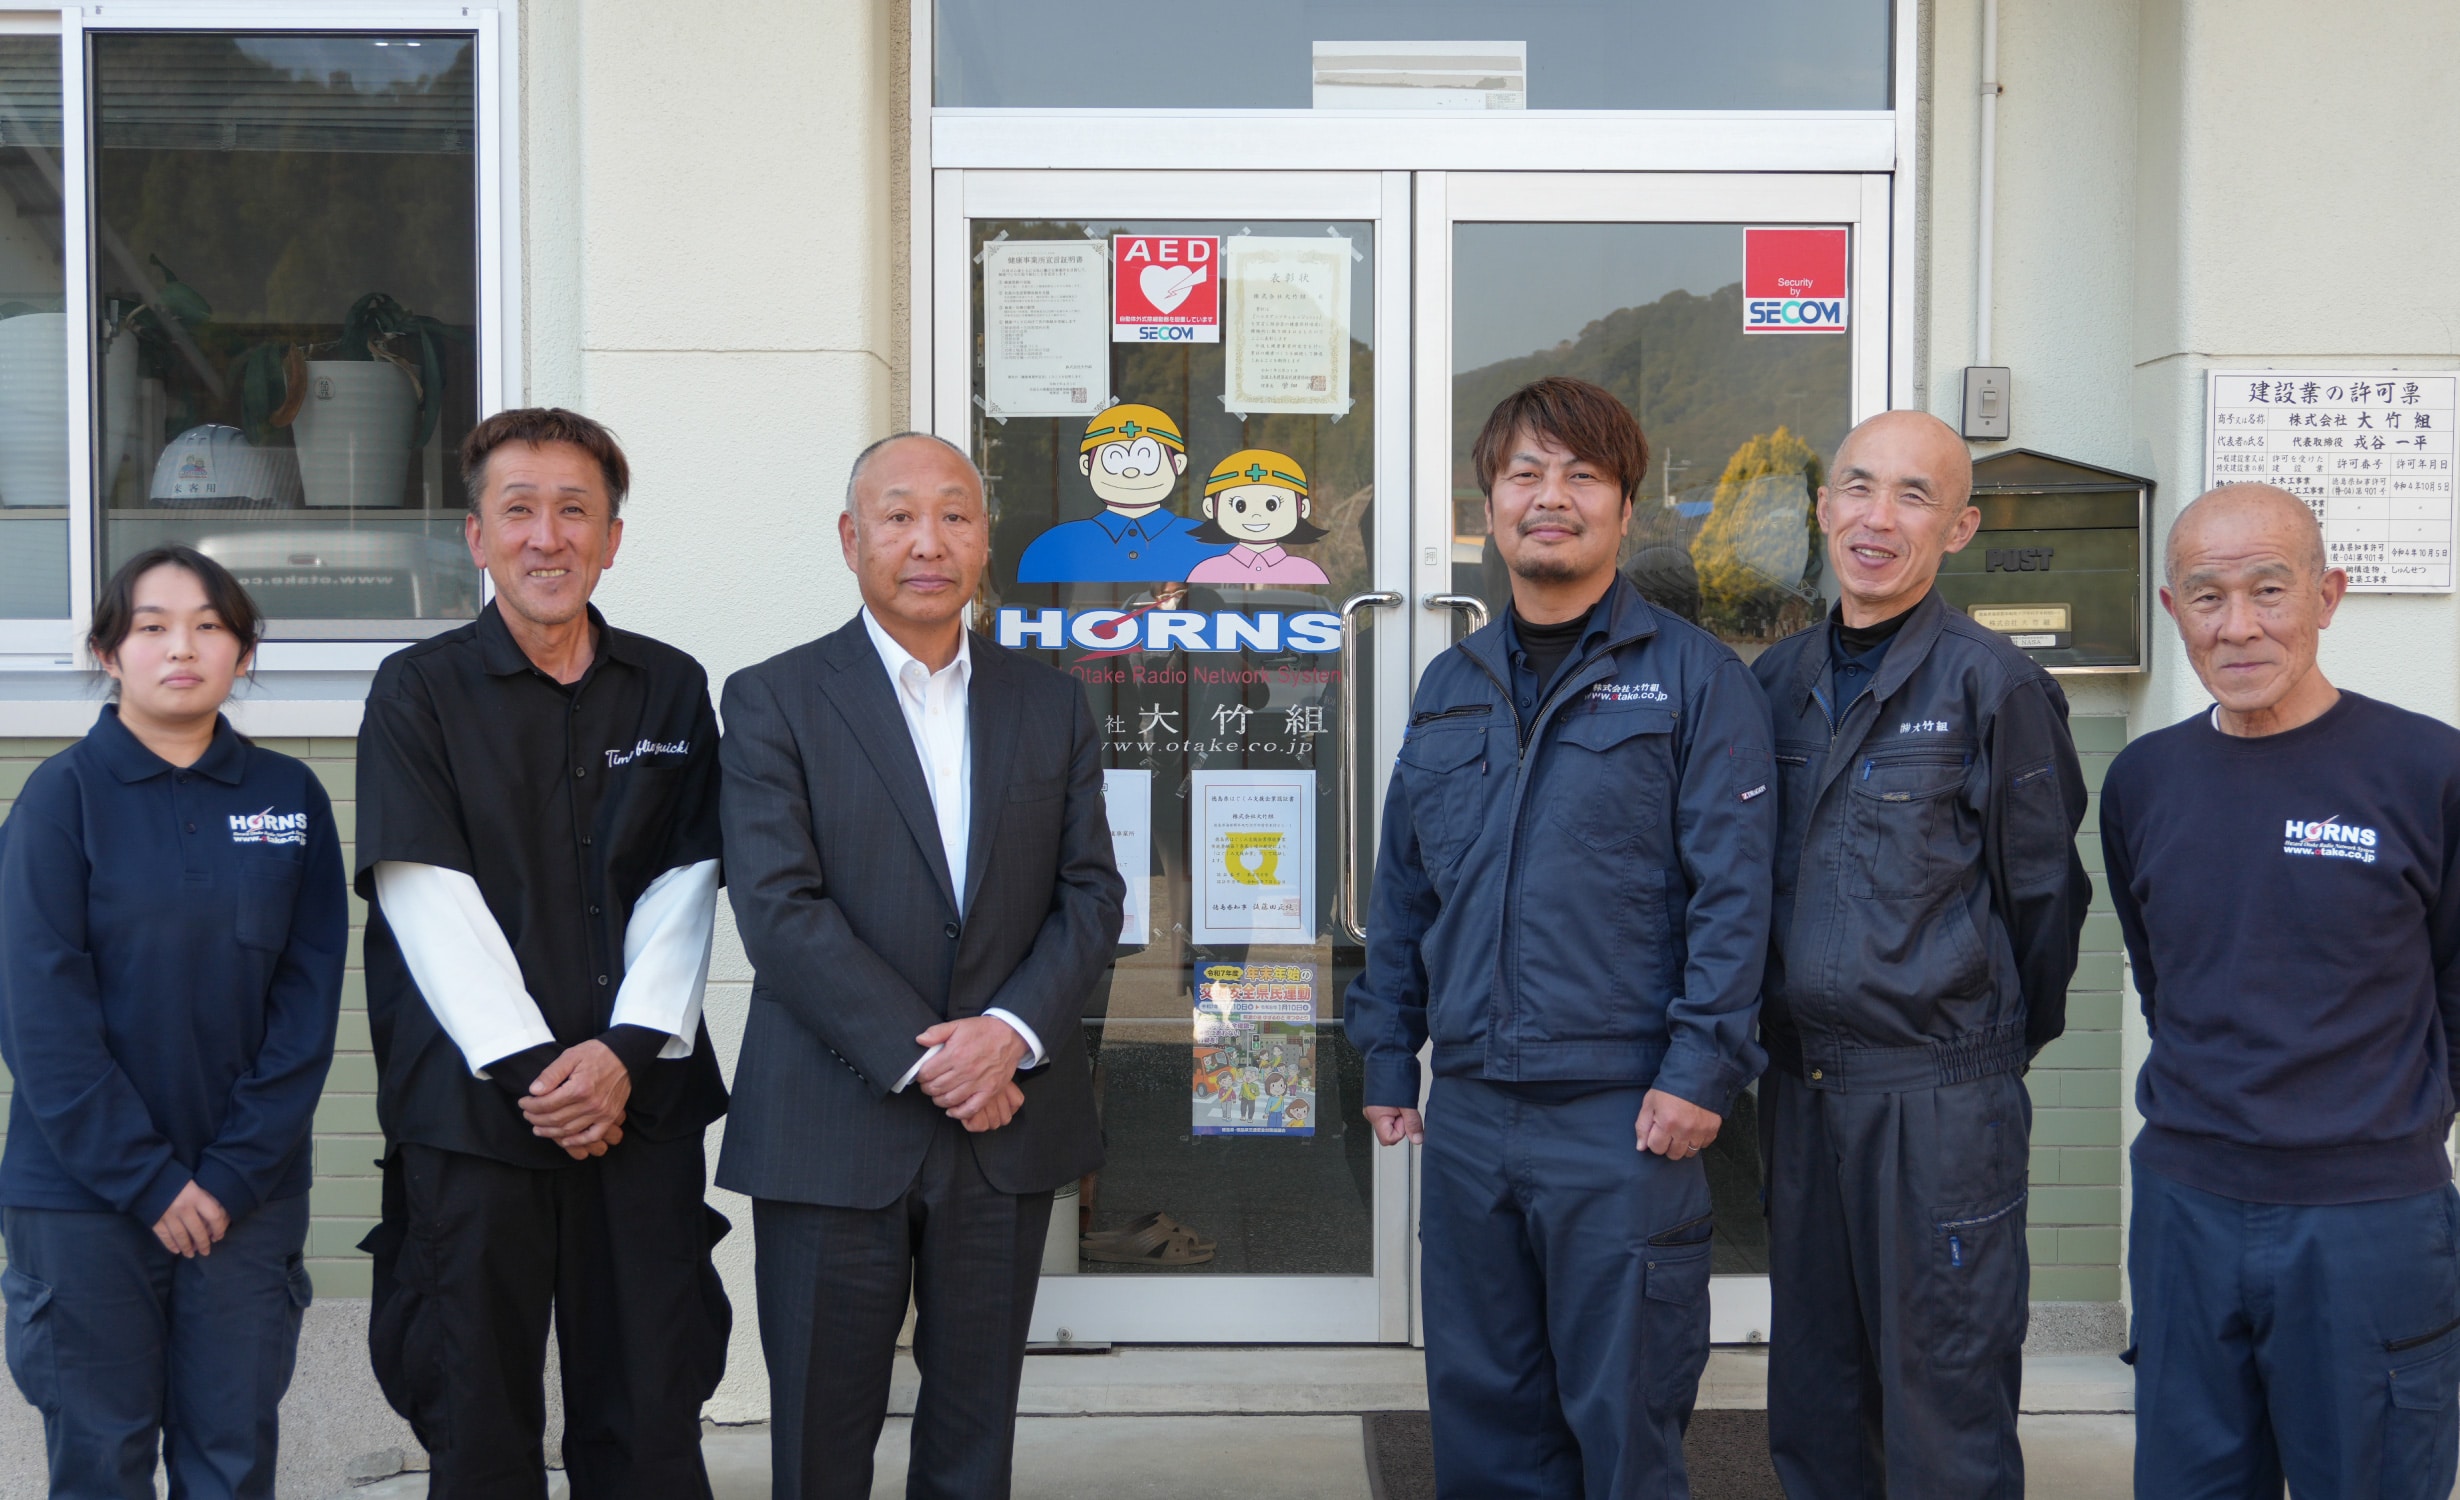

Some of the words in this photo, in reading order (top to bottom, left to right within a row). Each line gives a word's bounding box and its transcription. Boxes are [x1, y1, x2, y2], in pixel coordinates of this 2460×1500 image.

[1124, 240, 1211, 262] AED
[1271, 272, 1310, 283] 表彰状
[1778, 278, 1813, 289] Security
[1790, 287, 1801, 298] by
[1750, 300, 1841, 325] SECOM
[1139, 326, 1194, 341] SECOM
[2248, 380, 2422, 405] 建設業の許可票
[2217, 413, 2266, 425] 商号又は名称
[2289, 412, 2348, 427] 株式会社
[2357, 410, 2432, 429] 大竹組
[2217, 436, 2265, 447] 代表者の氏名
[2292, 436, 2344, 448] 代表取締役
[2272, 454, 2324, 463] 許可を受けた
[2336, 458, 2383, 469] 許可番号
[2396, 458, 2448, 470] 許可年月日
[2269, 476, 2311, 485] 土木工事業
[1985, 547, 2054, 572] POST
[996, 606, 1341, 652] HORNS
[1133, 665, 1187, 684] Radio
[1194, 665, 1271, 684] Network
[229, 812, 308, 830] HORNS
[2285, 819, 2377, 847] HORNS
[2283, 846, 2376, 862] www.otake.co.jp
[1207, 969, 1240, 977] 令和7年度
[1246, 965, 1314, 982] 年末年始の
[1199, 983, 1312, 1001] 交安全県民運動
